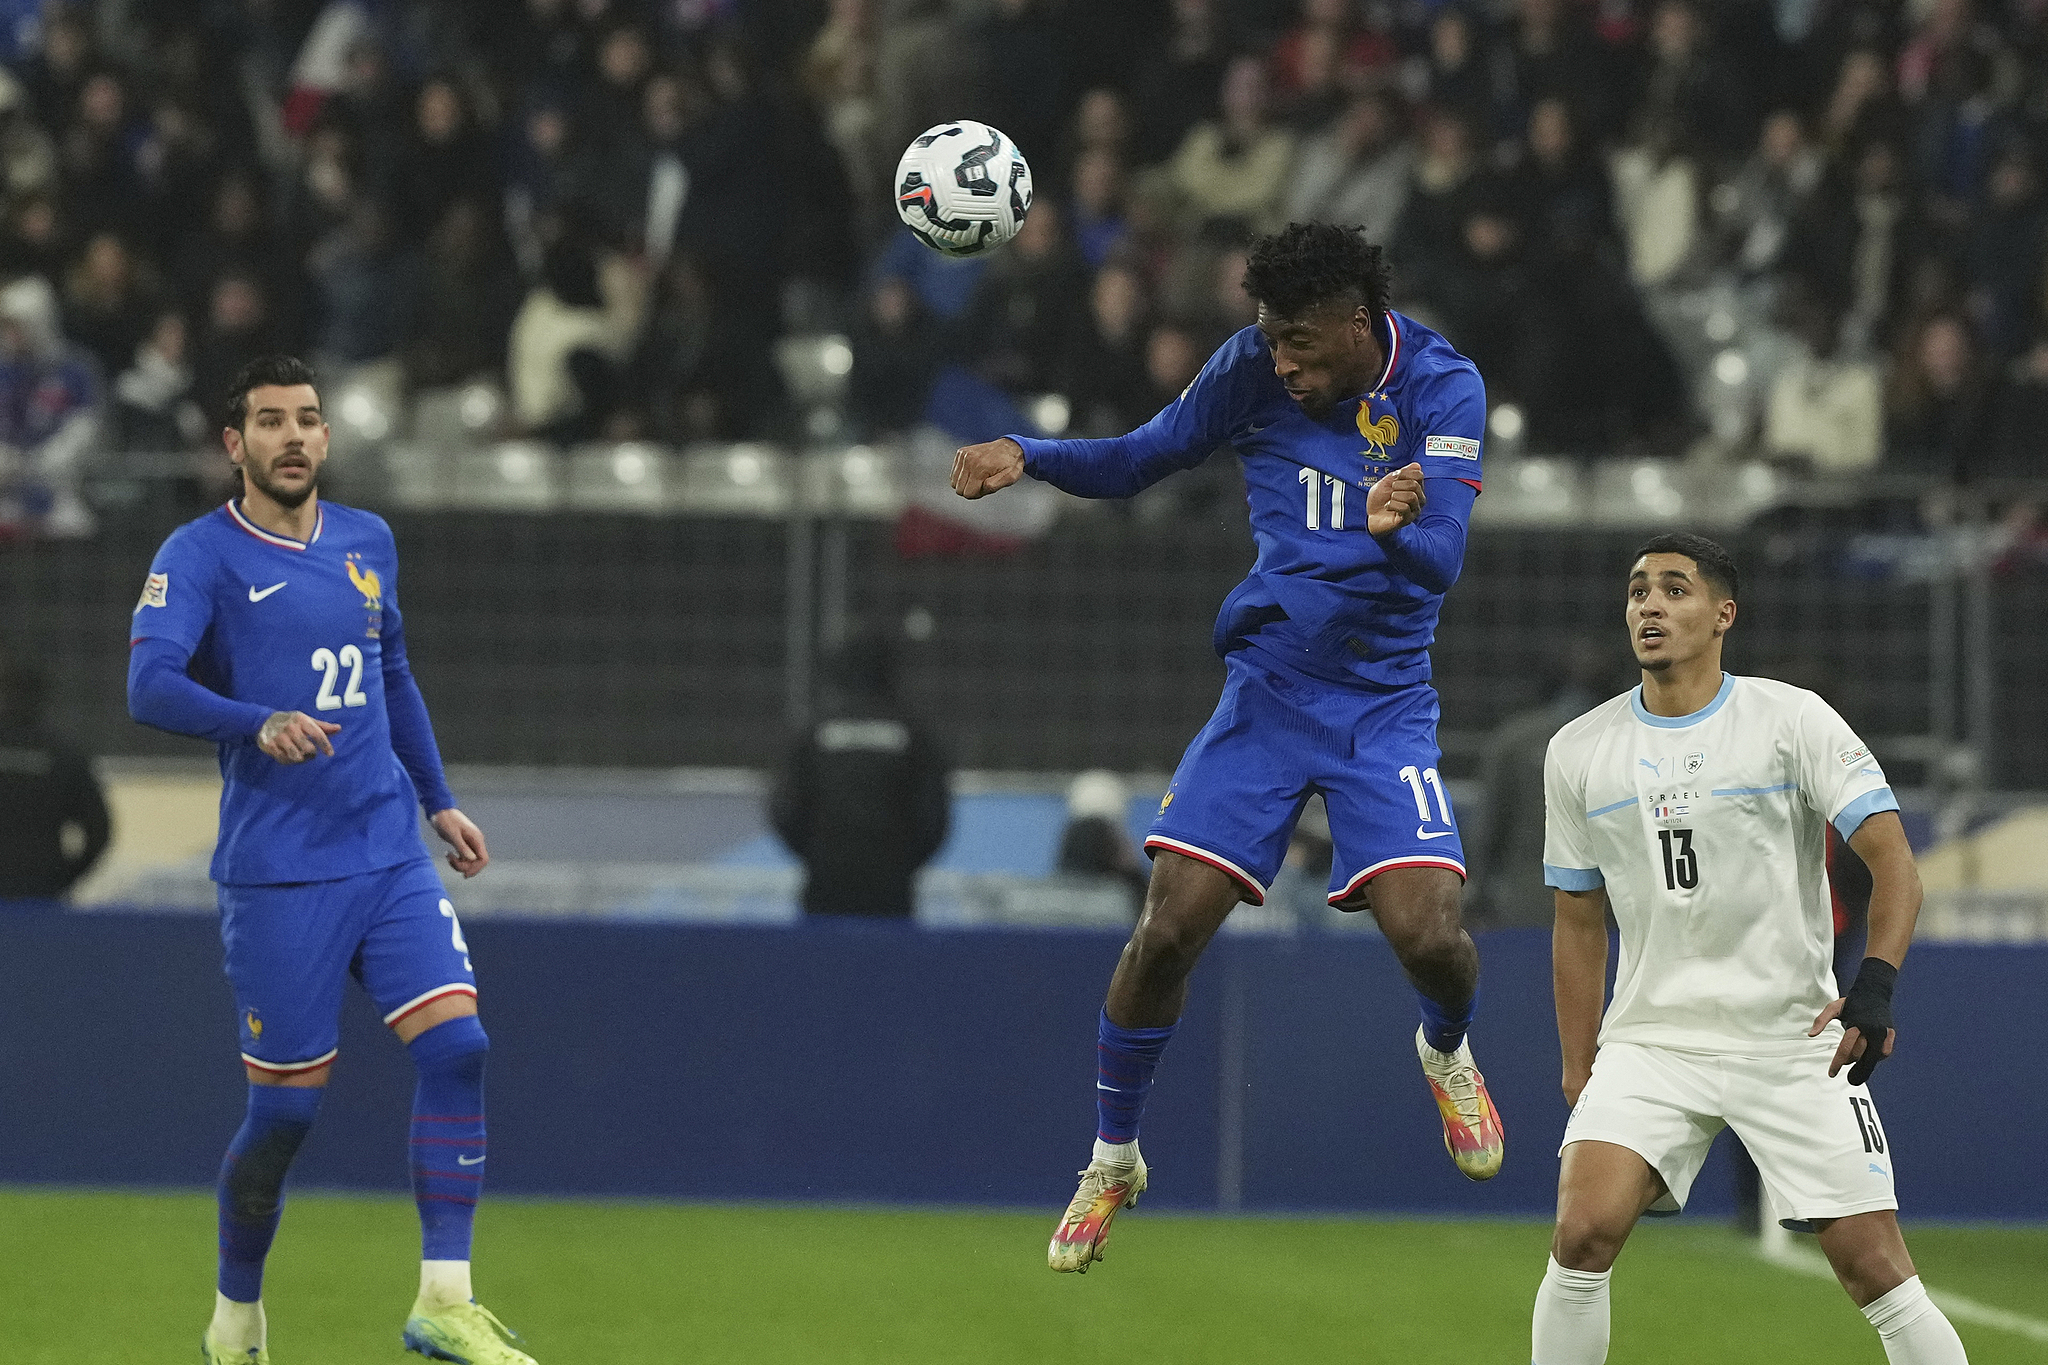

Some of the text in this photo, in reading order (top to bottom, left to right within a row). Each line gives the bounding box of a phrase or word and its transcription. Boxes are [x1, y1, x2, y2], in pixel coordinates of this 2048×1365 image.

[1427, 442, 1478, 454] FOUNDATION
[1299, 467, 1345, 530] 11
[311, 644, 367, 711] 22
[1399, 766, 1452, 826] 11
[1649, 791, 1700, 802] SRAEL
[1658, 829, 1698, 890] 13
[1849, 1097, 1884, 1154] 13
